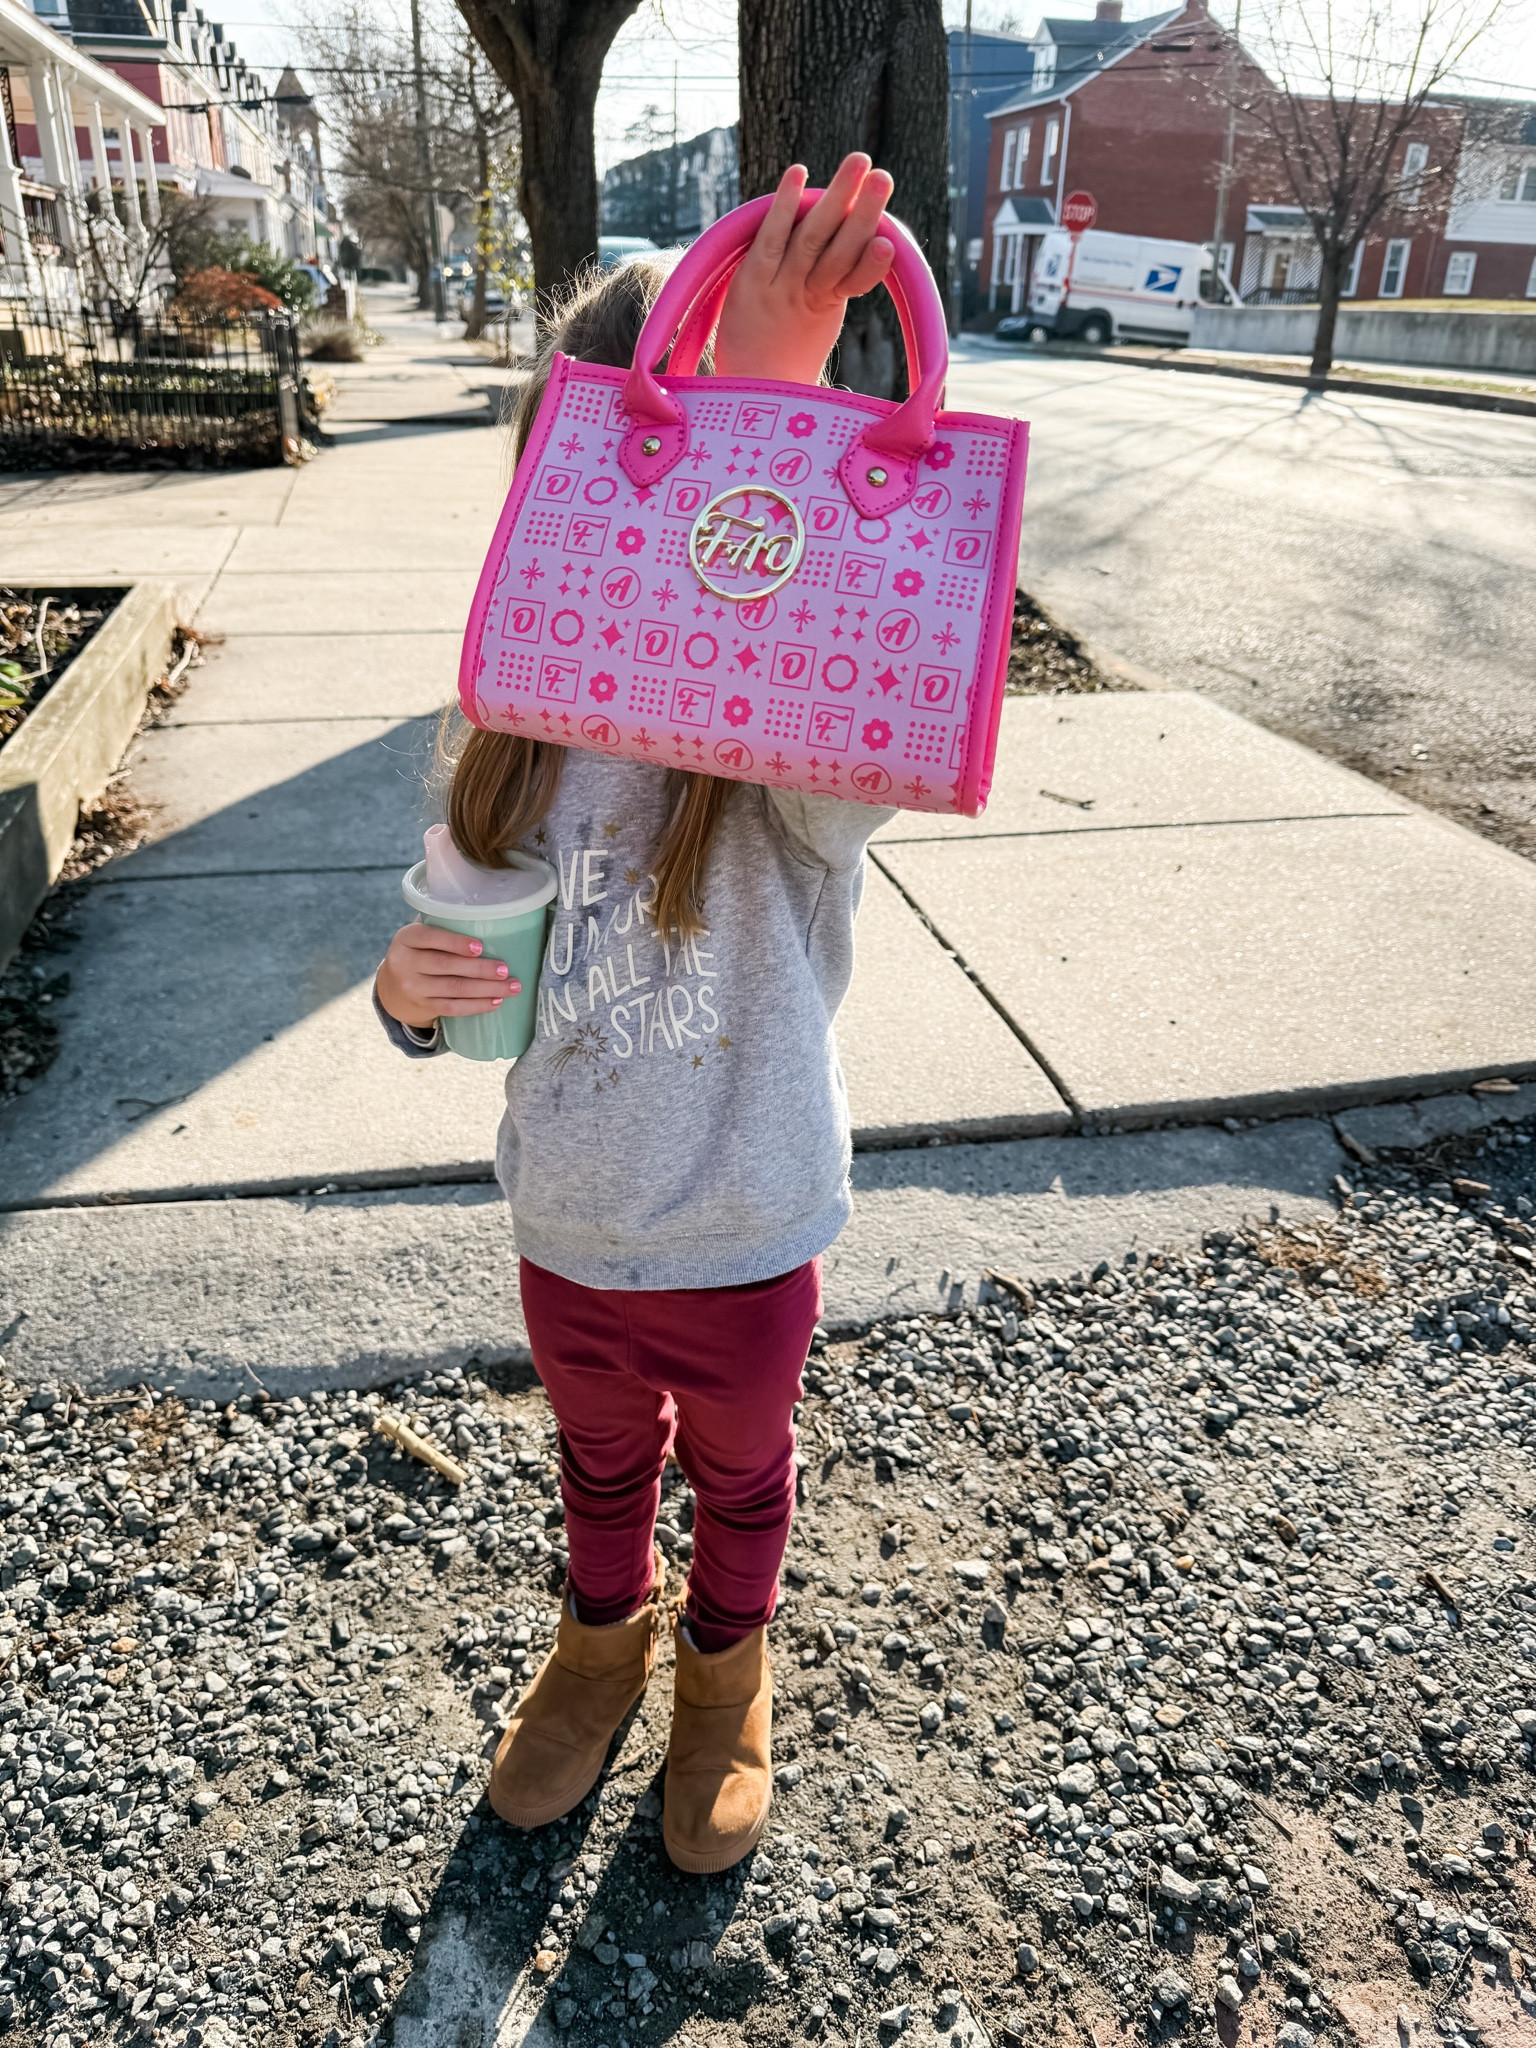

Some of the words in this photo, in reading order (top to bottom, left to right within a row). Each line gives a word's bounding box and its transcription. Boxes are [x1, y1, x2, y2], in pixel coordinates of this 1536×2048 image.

[1063, 204, 1095, 221] STOP
[775, 455, 803, 480] A
[914, 489, 943, 513] A
[696, 512, 799, 574] FAO
[606, 575, 633, 601] A
[741, 594, 769, 624] A
[882, 618, 911, 645] A
[587, 723, 609, 743] A
[720, 746, 744, 767] A
[856, 770, 882, 790] A
[557, 849, 609, 911] VE
[537, 982, 577, 1037] AN
[589, 944, 651, 1012] ALL
[610, 984, 720, 1059] STARS
